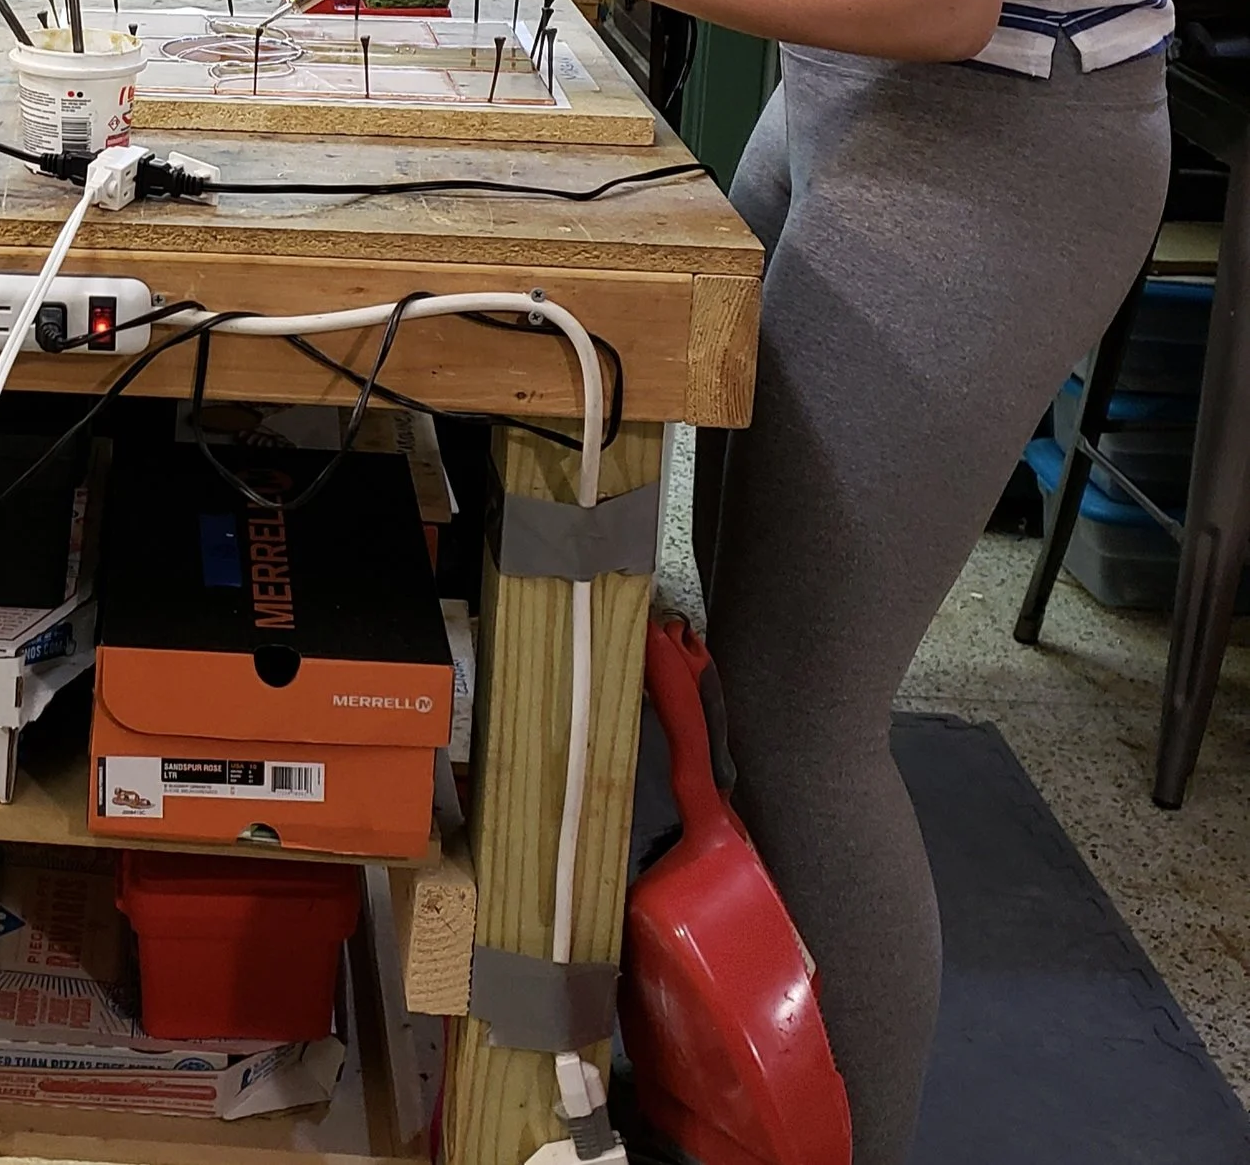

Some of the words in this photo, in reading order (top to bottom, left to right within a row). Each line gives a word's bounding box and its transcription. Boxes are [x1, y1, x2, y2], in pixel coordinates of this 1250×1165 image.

[333, 695, 415, 710] MERRELL
[164, 762, 202, 772] SANDSPUR
[203, 764, 223, 773] ROSE
[164, 772, 178, 780] LTR
[46, 877, 88, 969] REWARDS
[26, 923, 44, 965] PIECE
